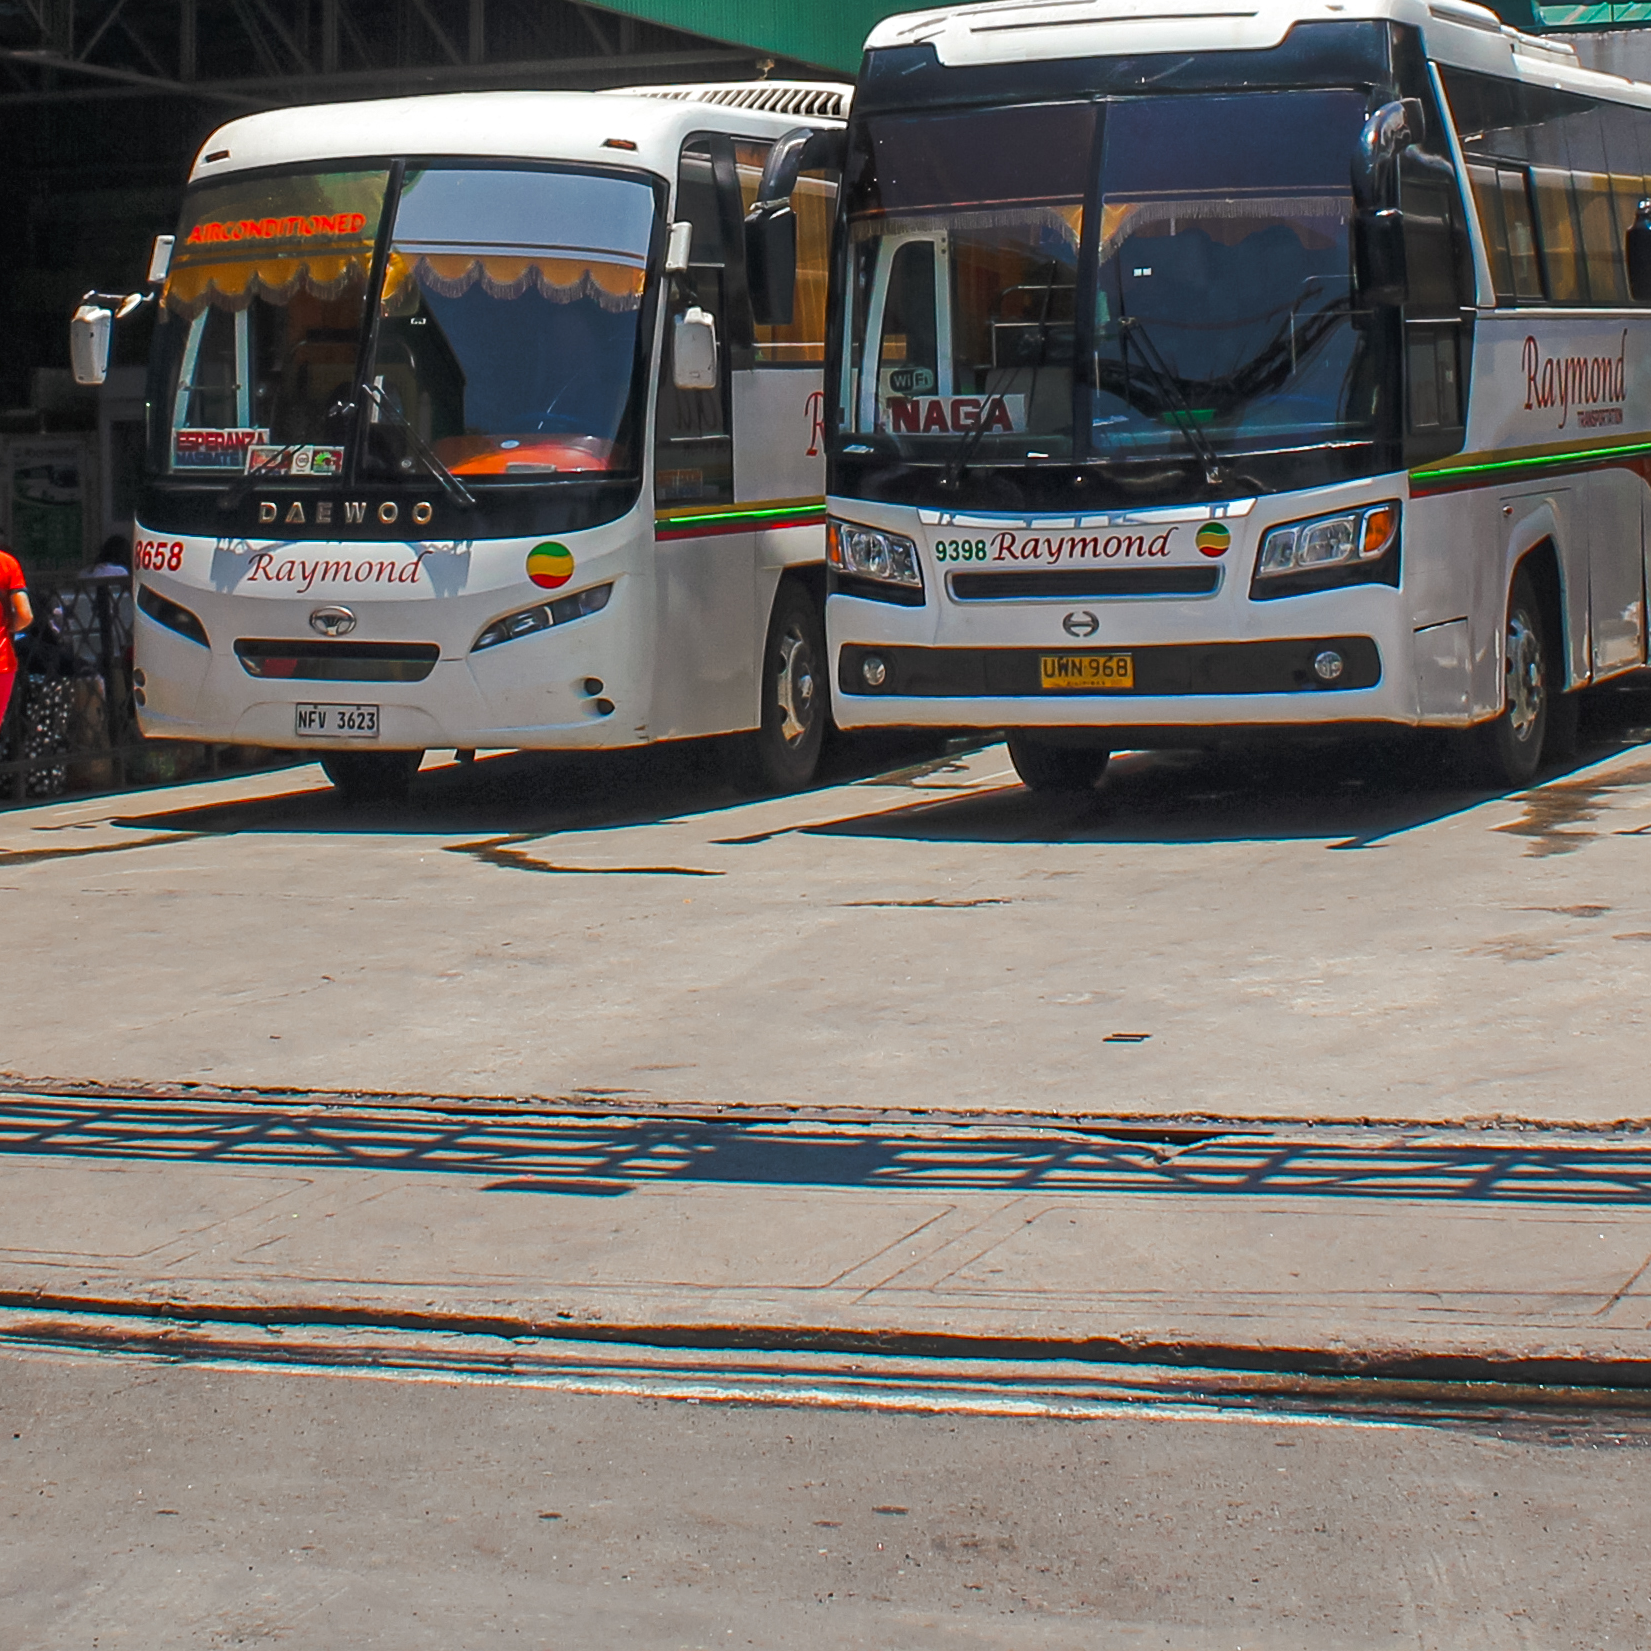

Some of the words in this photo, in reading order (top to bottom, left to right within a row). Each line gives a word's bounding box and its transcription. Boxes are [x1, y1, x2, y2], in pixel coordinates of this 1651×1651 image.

[187, 212, 367, 244] AIRCONDITIONED
[1521, 327, 1628, 428] Raymond
[891, 398, 1013, 433] NAGA
[258, 501, 433, 525] DAEWOO
[135, 541, 184, 572] 8658
[935, 539, 988, 562] 9398
[990, 526, 1180, 565] Raymond
[247, 550, 434, 594] Raymond
[1043, 657, 1083, 678] UWN
[1088, 656, 1128, 678] 968
[298, 711, 326, 729] NFV
[337, 711, 376, 730] 3623
